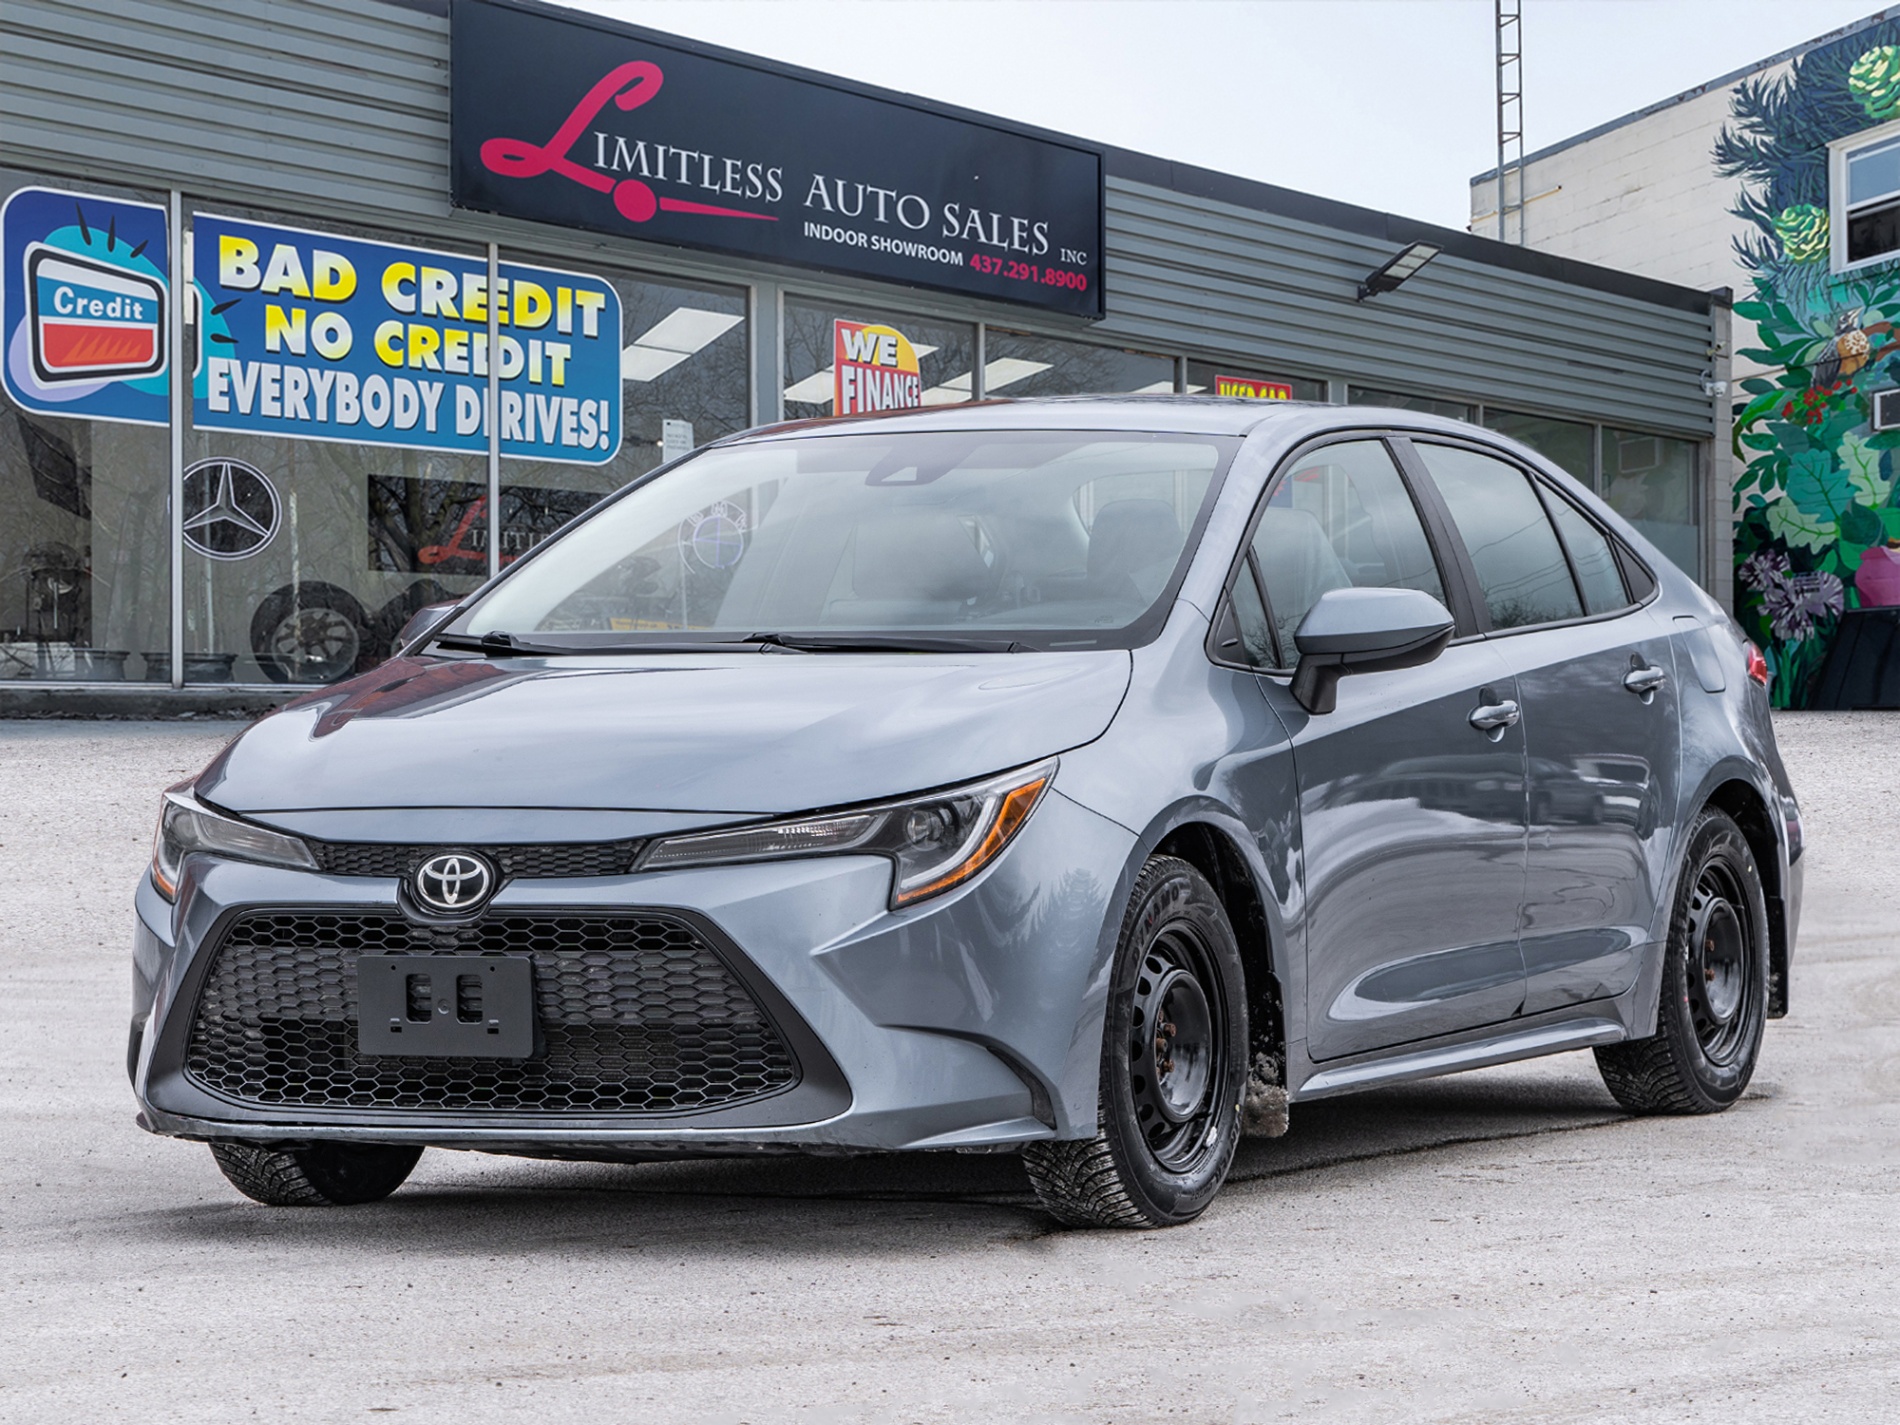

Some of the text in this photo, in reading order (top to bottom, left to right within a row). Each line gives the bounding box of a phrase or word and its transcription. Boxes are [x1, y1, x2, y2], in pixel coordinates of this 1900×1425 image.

[480, 60, 1088, 266] LIMITLESS AUTO SALES INC
[218, 234, 607, 339] BAD CREDIT
[804, 221, 1088, 292] INDOOR SHOWROOM 437.291.8900
[53, 286, 143, 320] Credit
[265, 304, 572, 387] NO CREDIT
[841, 328, 898, 368] WE
[208, 356, 610, 450] EVERYBODY DRIVES!
[841, 364, 920, 415] FINANCE
